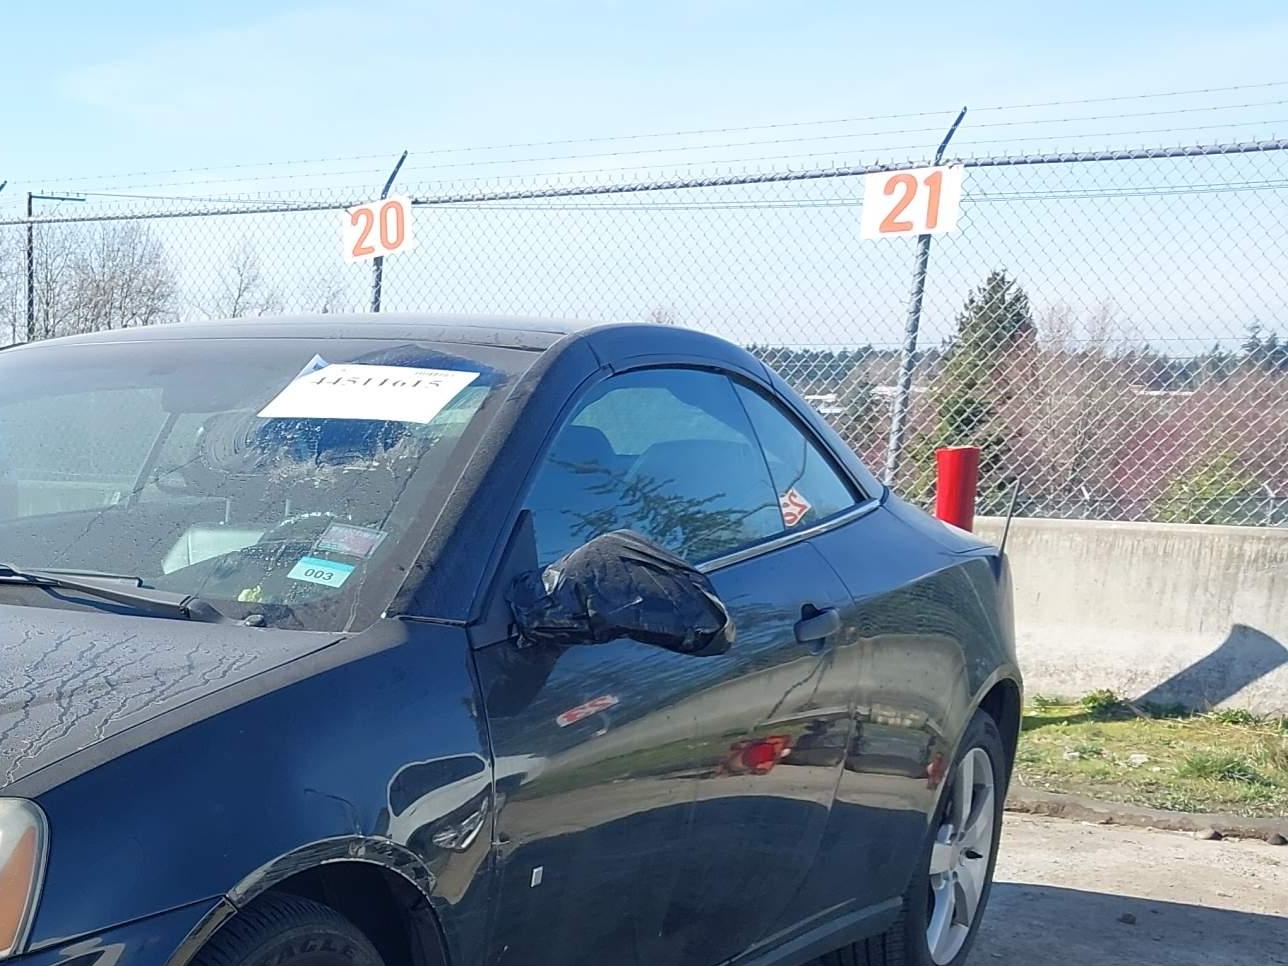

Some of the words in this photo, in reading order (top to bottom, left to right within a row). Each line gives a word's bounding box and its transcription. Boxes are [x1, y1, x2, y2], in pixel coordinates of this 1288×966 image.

[351, 201, 405, 256] 20
[879, 171, 943, 233] 21
[304, 568, 334, 581] 003
